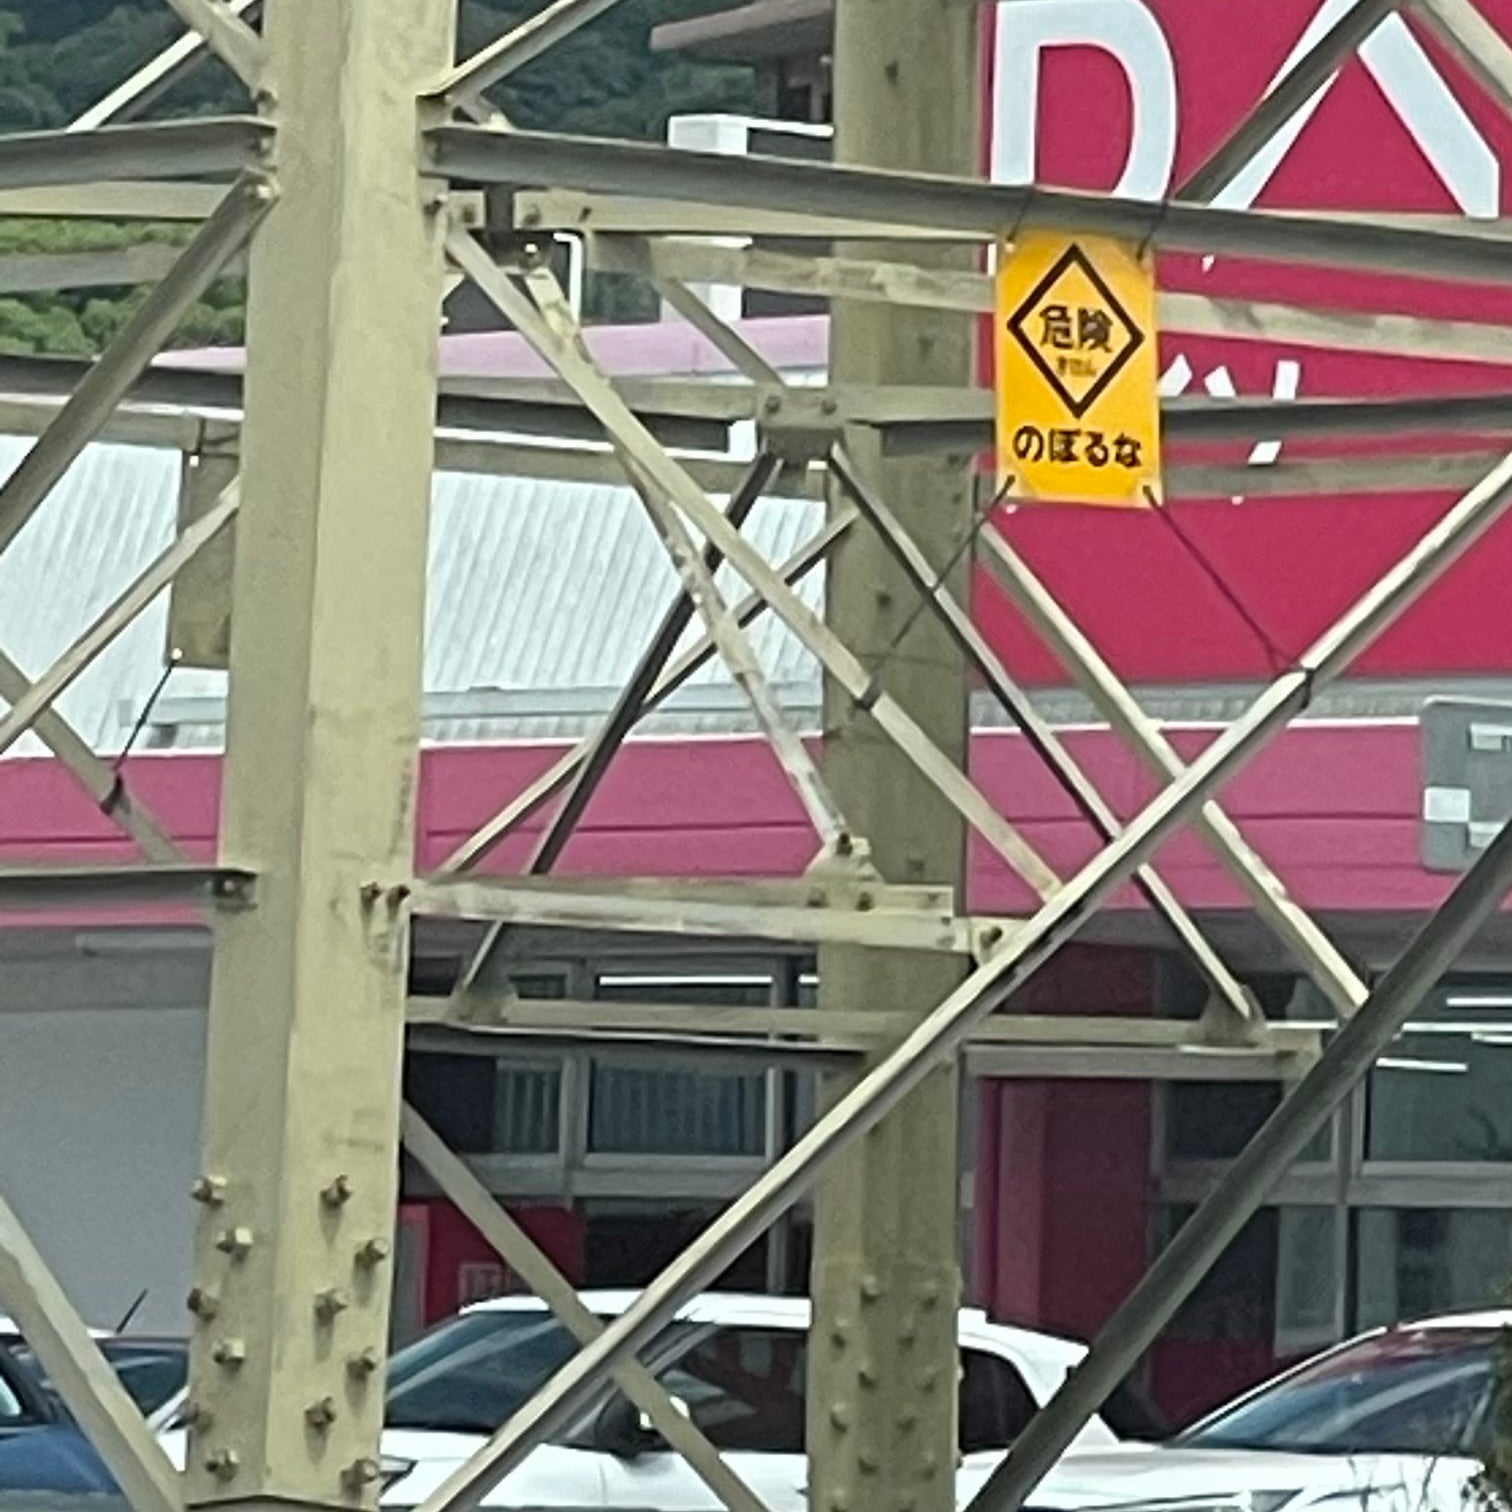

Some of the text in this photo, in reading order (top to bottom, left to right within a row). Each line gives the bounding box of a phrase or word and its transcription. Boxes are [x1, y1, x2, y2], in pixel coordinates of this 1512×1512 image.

[1039, 304, 1114, 353] 危険
[1012, 426, 1142, 469] のぼるな
